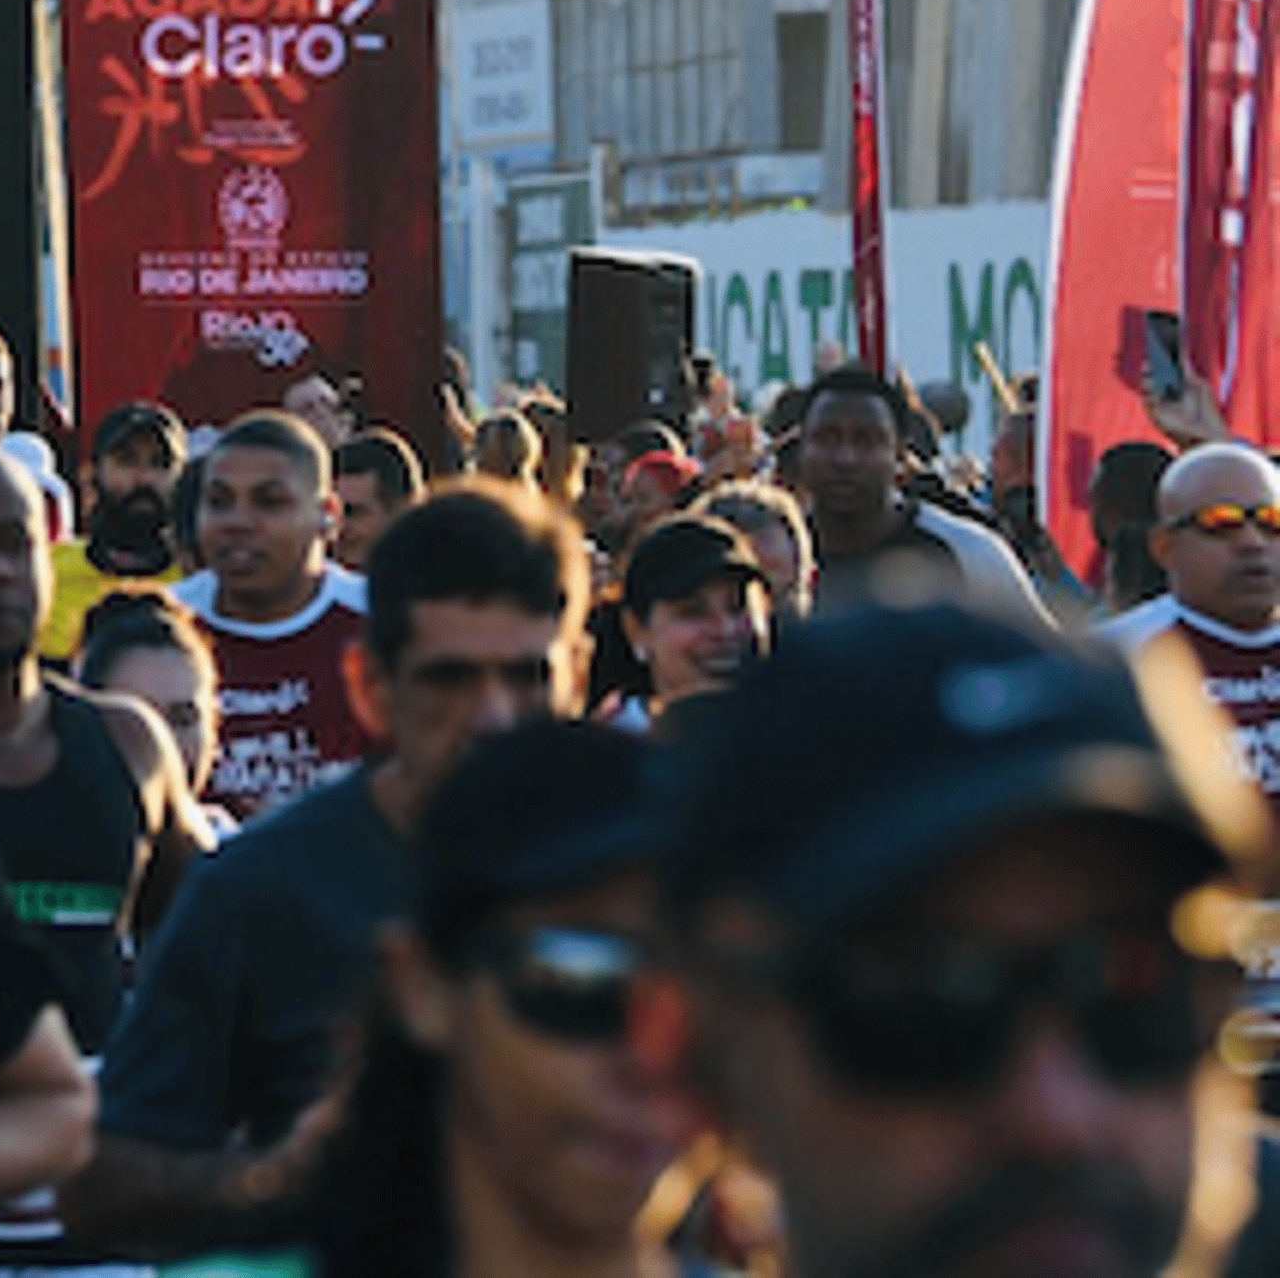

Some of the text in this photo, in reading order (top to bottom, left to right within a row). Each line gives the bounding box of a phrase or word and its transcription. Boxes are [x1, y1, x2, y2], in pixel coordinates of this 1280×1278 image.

[140, 10, 346, 79] Claro
[139, 268, 369, 295] RIO DE JANEIRO
